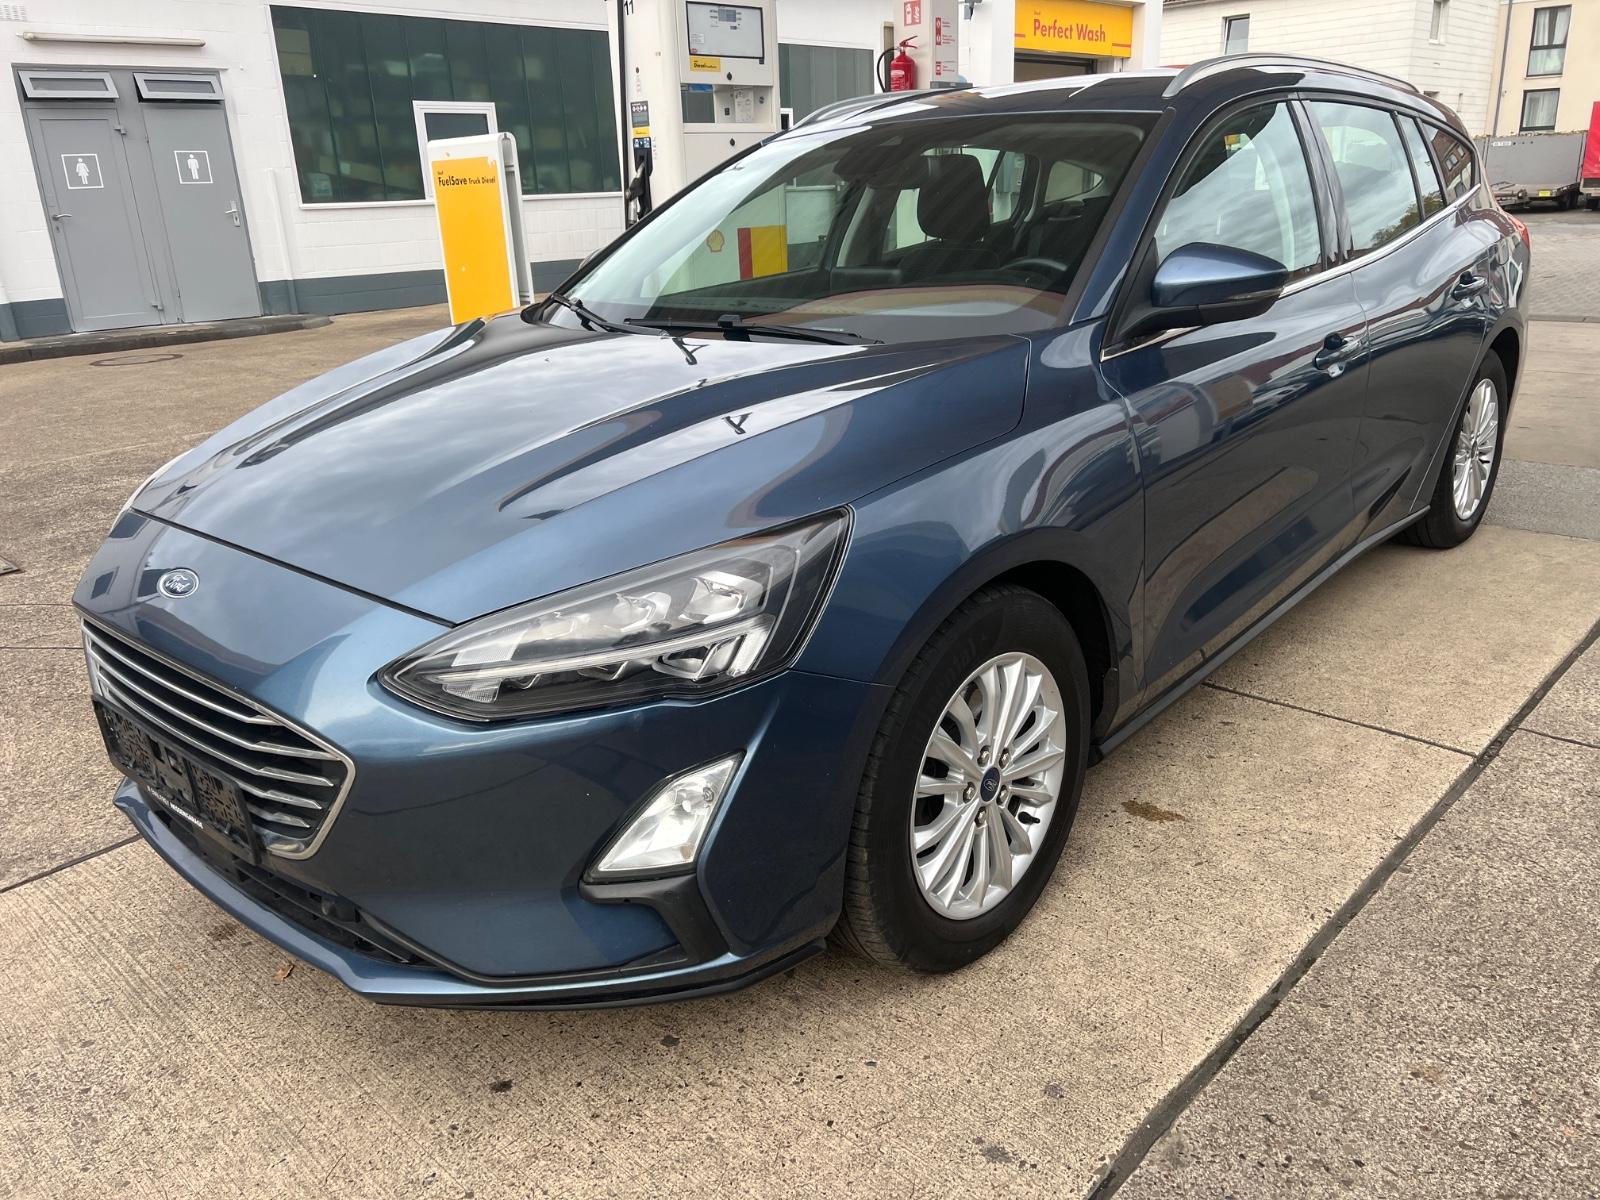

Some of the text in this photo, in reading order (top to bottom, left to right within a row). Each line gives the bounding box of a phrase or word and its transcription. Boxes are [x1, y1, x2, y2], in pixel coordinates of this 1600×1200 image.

[623, 0, 634, 16] 11
[1033, 18, 1106, 43] Perfect Wash
[438, 176, 467, 187] FuelSave
[482, 176, 496, 184] Diesel
